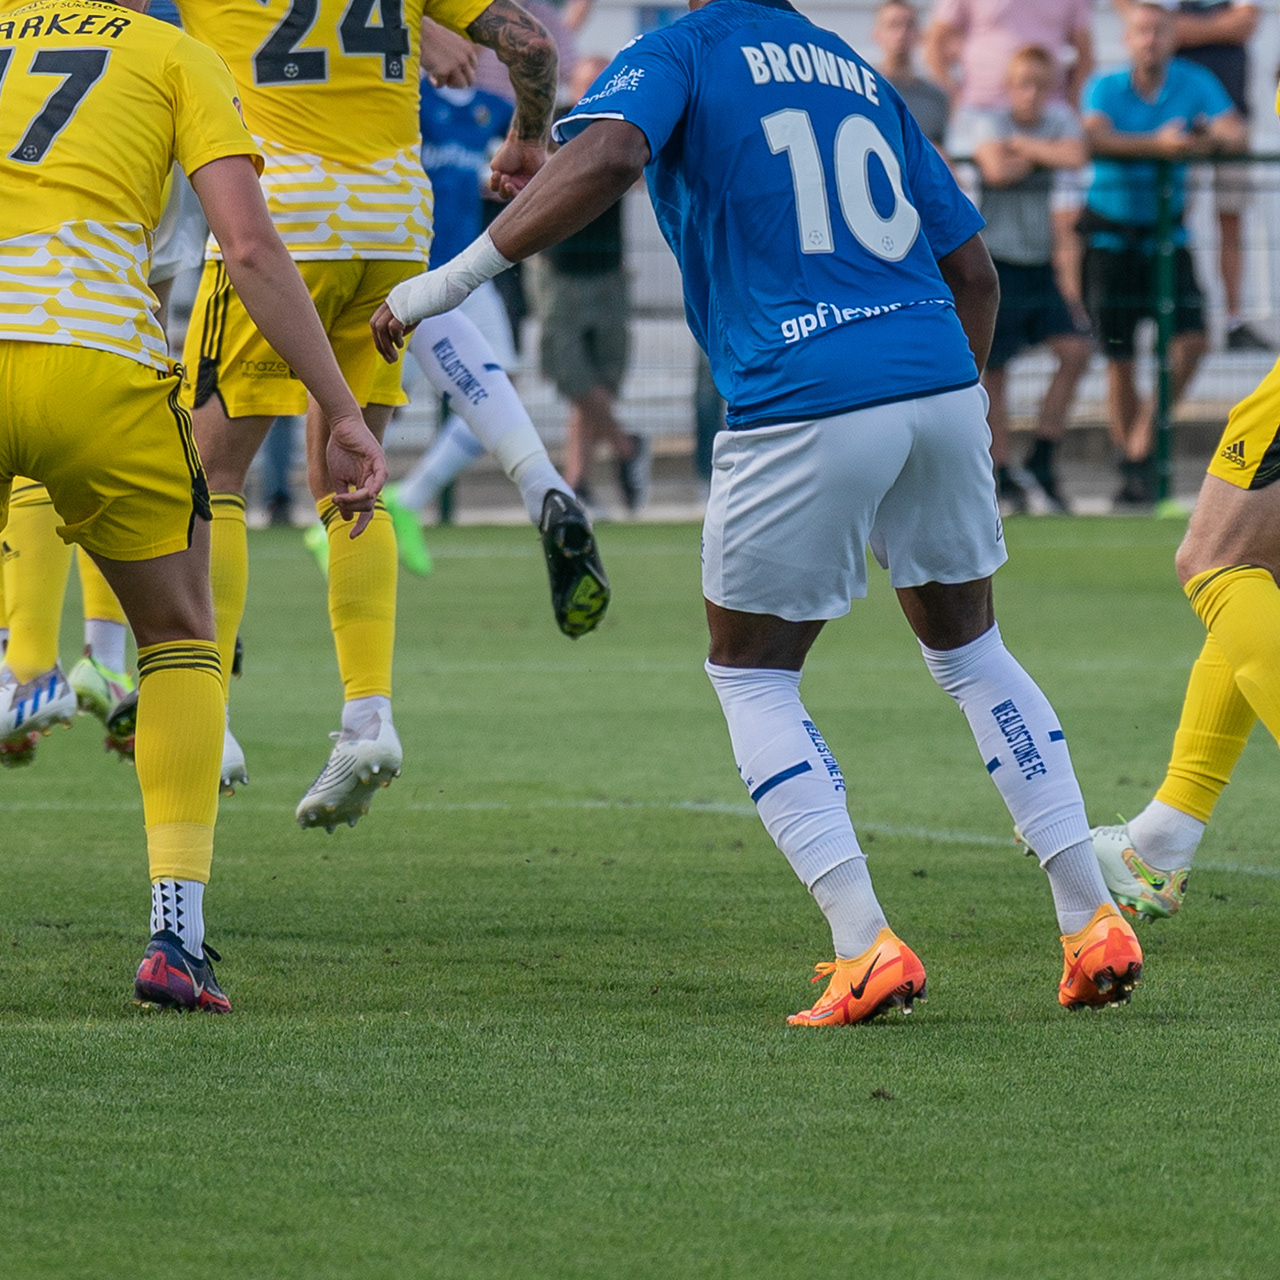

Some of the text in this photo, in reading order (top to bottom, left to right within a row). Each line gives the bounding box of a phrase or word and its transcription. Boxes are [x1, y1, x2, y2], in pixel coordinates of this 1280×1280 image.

[741, 42, 880, 107] BROWNE
[760, 107, 921, 262] 10
[469, 387, 489, 405] FC
[1221, 450, 1246, 468] adidas
[991, 698, 1048, 781] WEALDSTONE FC
